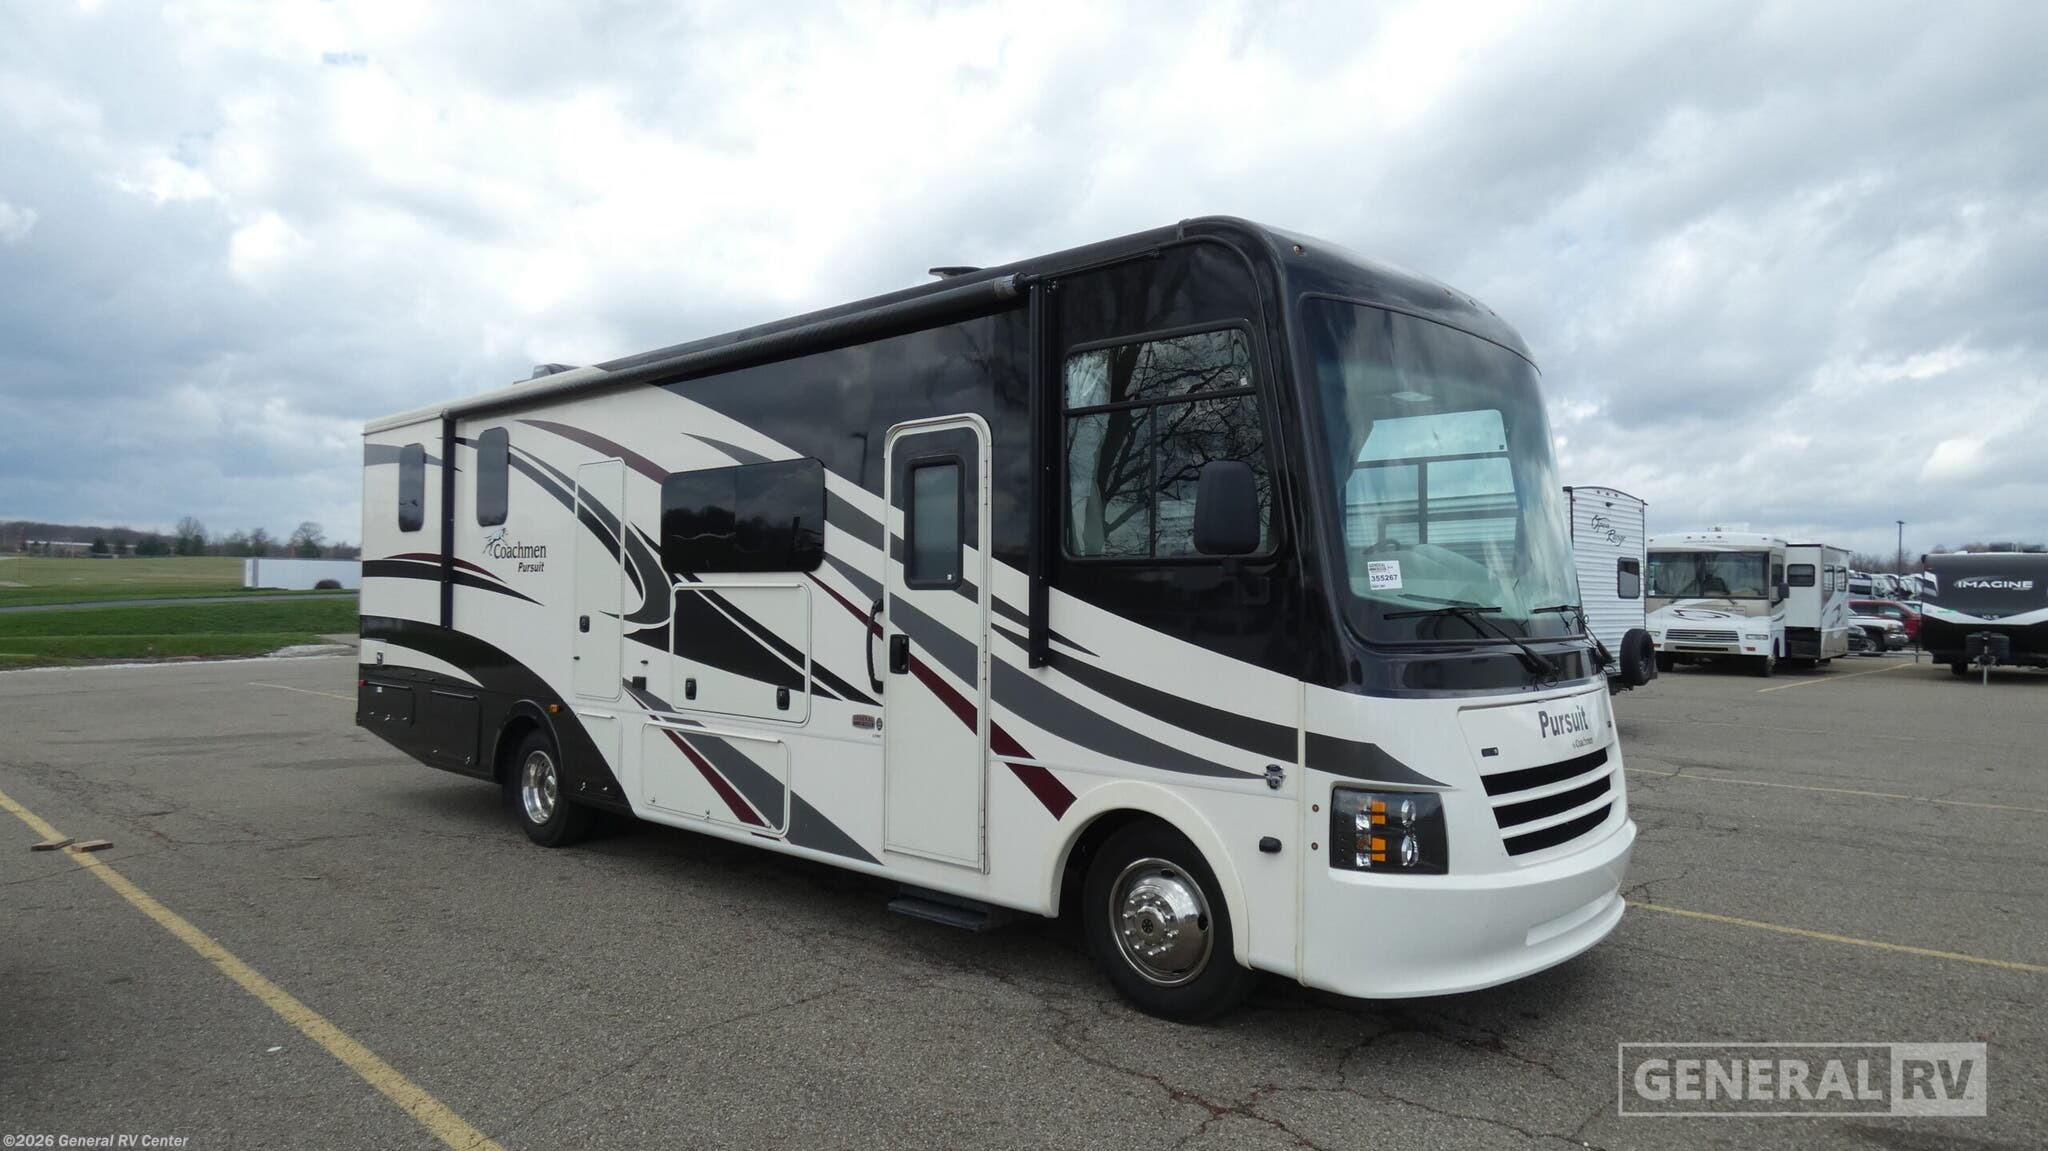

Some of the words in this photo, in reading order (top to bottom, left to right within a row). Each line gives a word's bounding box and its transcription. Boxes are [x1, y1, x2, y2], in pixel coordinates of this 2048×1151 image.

[494, 541, 547, 559] Coachmen
[518, 561, 544, 572] Pursuit
[1371, 574, 1398, 582] 355267
[1958, 580, 2033, 589] IMAGINE
[1538, 705, 1588, 738] Pursuit
